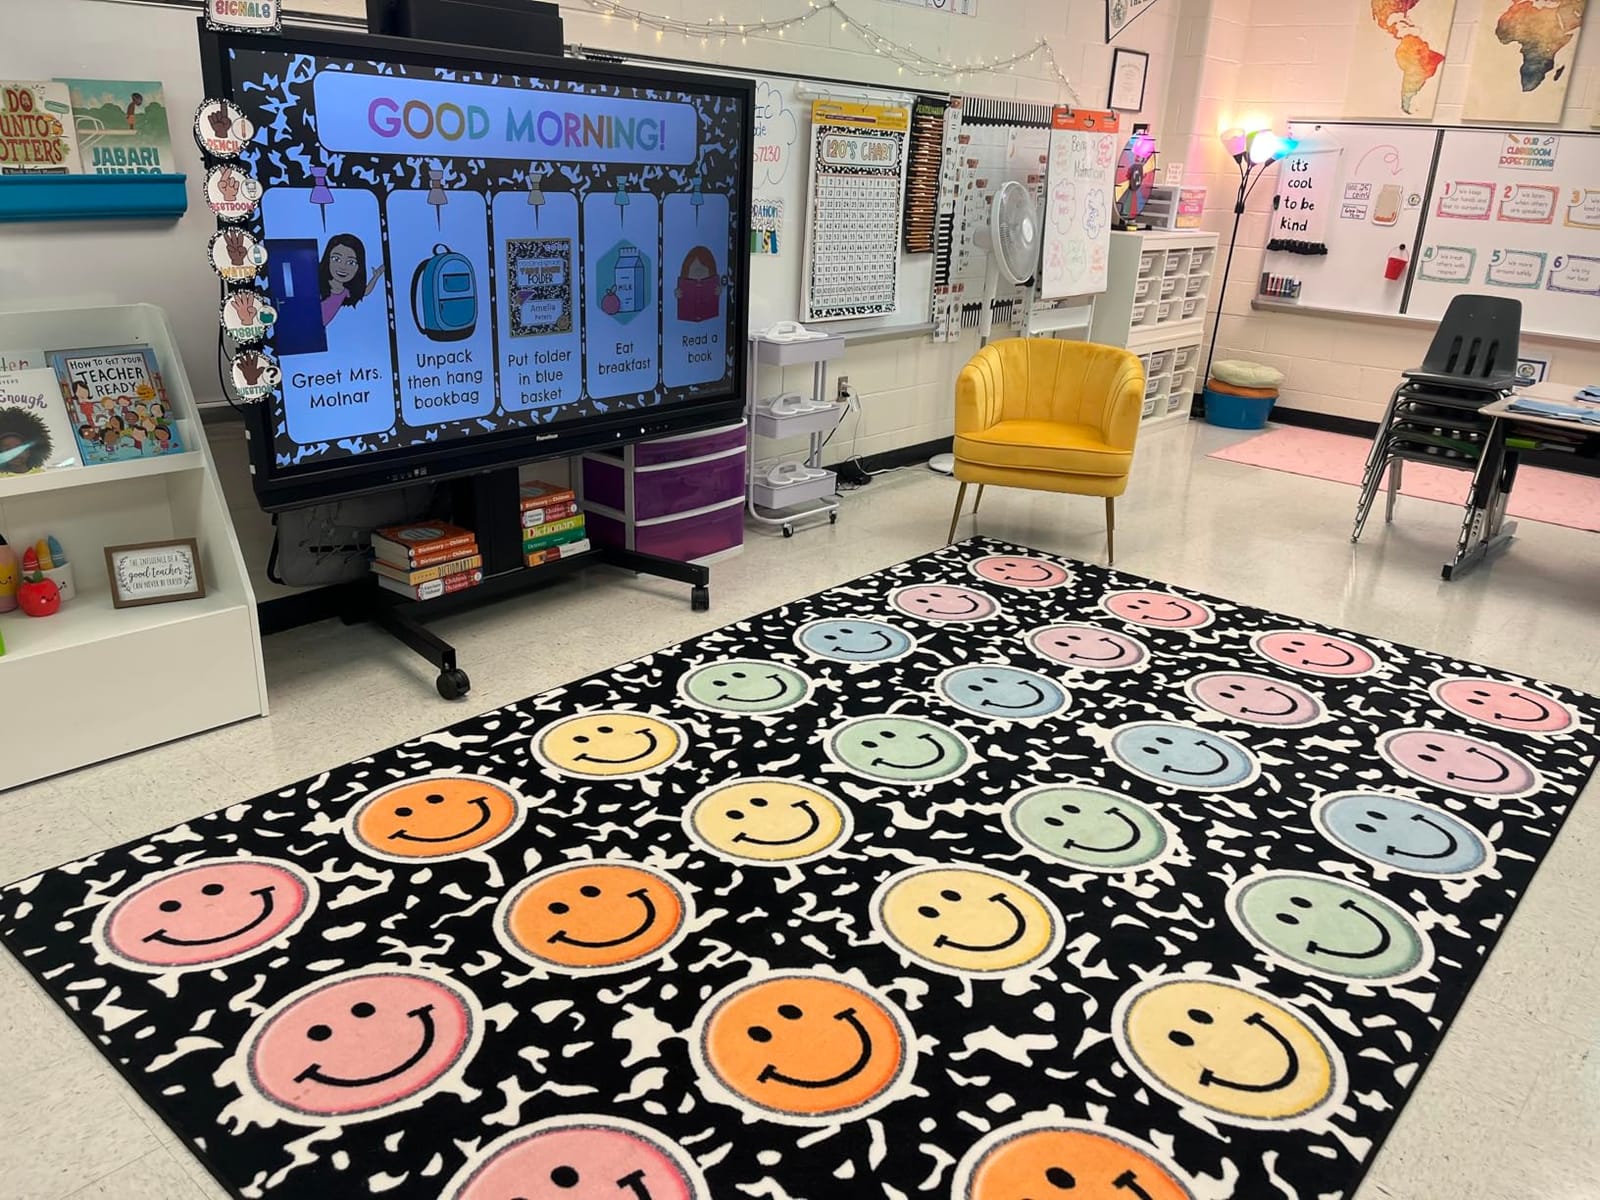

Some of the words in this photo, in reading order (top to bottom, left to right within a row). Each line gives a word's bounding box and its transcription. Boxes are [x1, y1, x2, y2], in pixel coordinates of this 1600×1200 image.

[6, 89, 33, 112] DO
[0, 115, 48, 137] UNTO
[368, 97, 490, 141] GOOD
[506, 107, 665, 151] MORNING!
[207, 138, 240, 152] PENCIL
[861, 142, 893, 161] CHART
[92, 147, 160, 167] JABARI
[1291, 160, 1309, 172] it's
[1288, 177, 1313, 189] cool
[1504, 185, 1512, 198] 2
[210, 202, 255, 212] RESTROOM
[1284, 197, 1297, 210] to
[1300, 197, 1315, 211] be
[1280, 217, 1308, 231] kind
[1424, 247, 1433, 258] 4
[1491, 250, 1501, 262] 5
[1554, 256, 1562, 268] 6
[220, 266, 256, 278] WATER
[228, 326, 264, 338] TISSUE
[682, 334, 708, 347] Read
[616, 342, 633, 355] Eat
[70, 360, 91, 369] HOW
[416, 349, 473, 369] Unpack
[508, 353, 528, 367] Put
[534, 349, 571, 365] folder
[688, 352, 713, 363] book
[598, 358, 651, 375] breakfast
[75, 367, 144, 384] TEACHER
[292, 371, 342, 388] Greet
[350, 367, 383, 381] Mrs.
[408, 375, 440, 389] then
[447, 369, 483, 385] hang
[519, 374, 531, 385] in
[535, 370, 563, 383] blue
[95, 382, 136, 396] READY
[521, 388, 562, 404] basket
[310, 390, 370, 408] Molnar
[414, 390, 480, 409] bookbag
[528, 521, 575, 537] Dictionary
[420, 554, 446, 564] Dictionary
[129, 566, 150, 582] good
[152, 564, 182, 577] teacher
